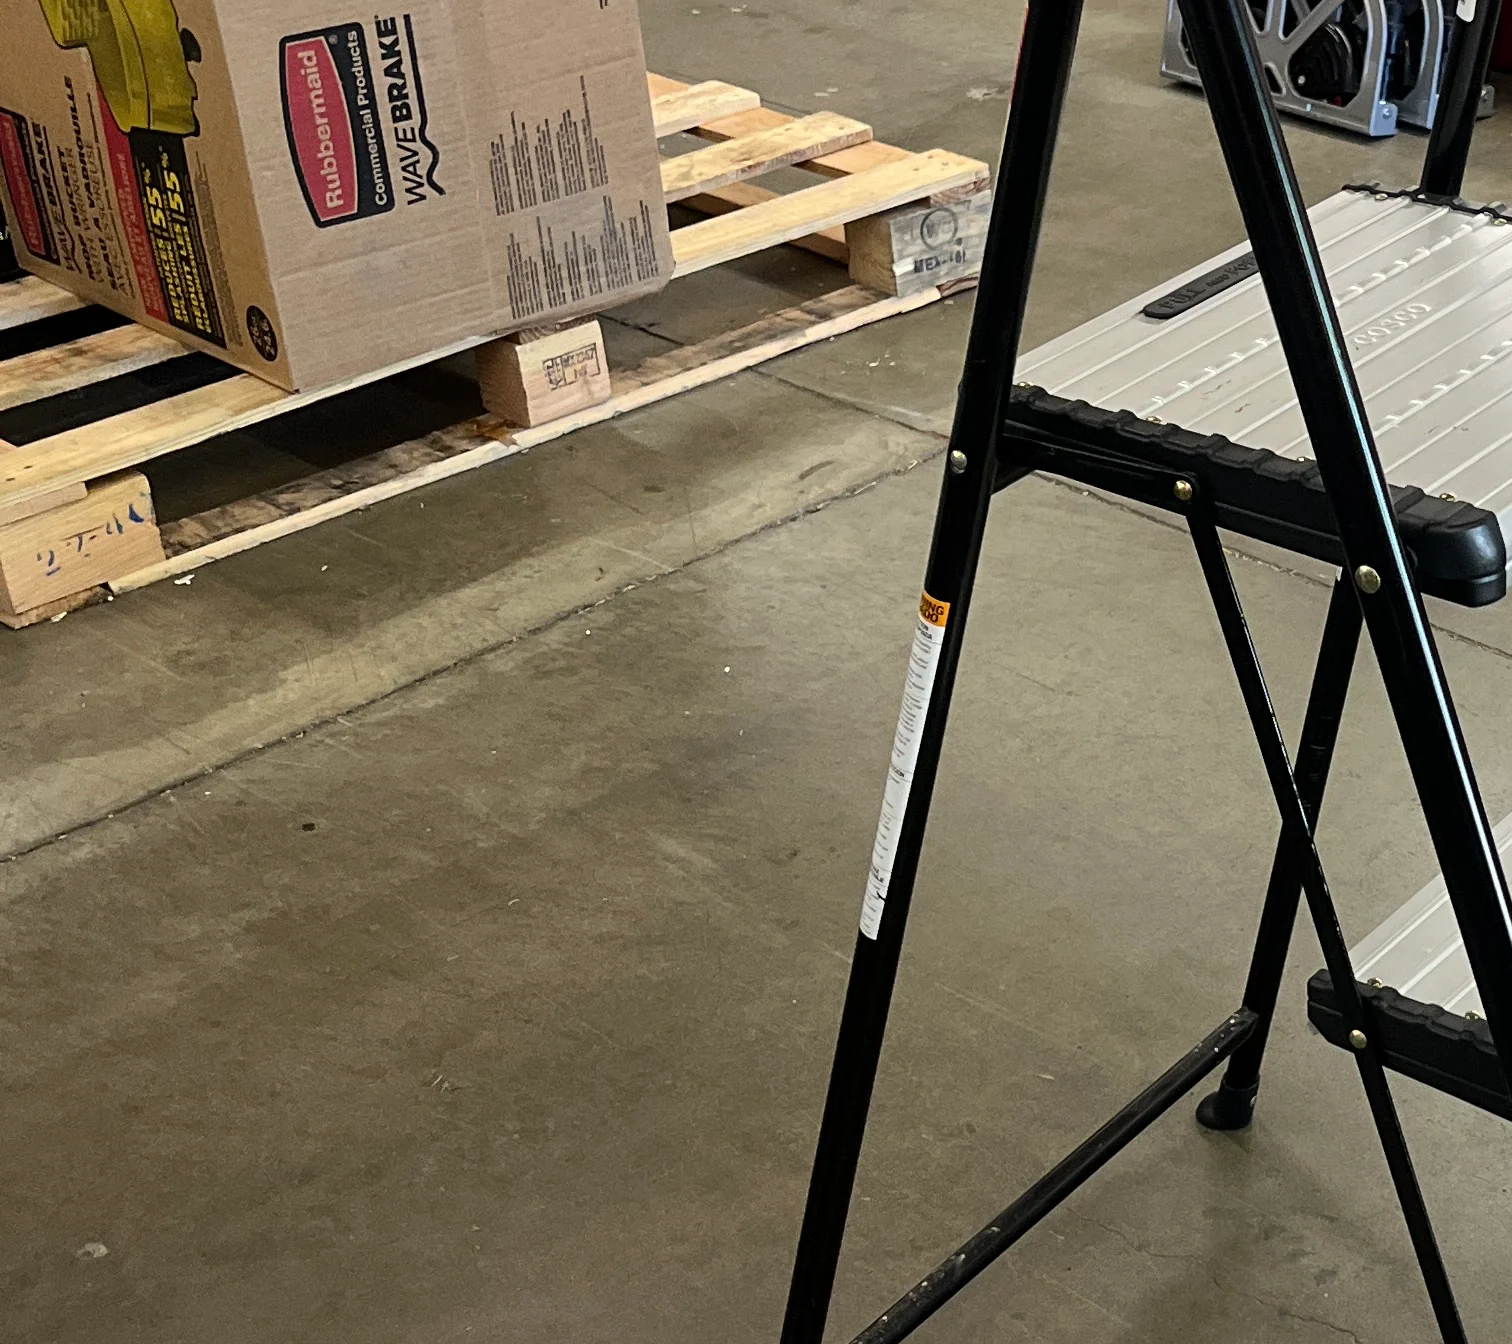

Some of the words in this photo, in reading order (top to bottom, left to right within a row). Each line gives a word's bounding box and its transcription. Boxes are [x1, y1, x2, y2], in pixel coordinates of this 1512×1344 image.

[347, 30, 370, 106] Products
[375, 15, 413, 124] BRAKE
[32, 121, 58, 207] BRAKE
[297, 50, 344, 209] Rubbermaid
[359, 108, 388, 206] Commercial
[394, 125, 428, 206] WAVE
[56, 145, 81, 227] BUCKET
[51, 210, 75, 271] WAVE
[77, 234, 96, 281] MOP
